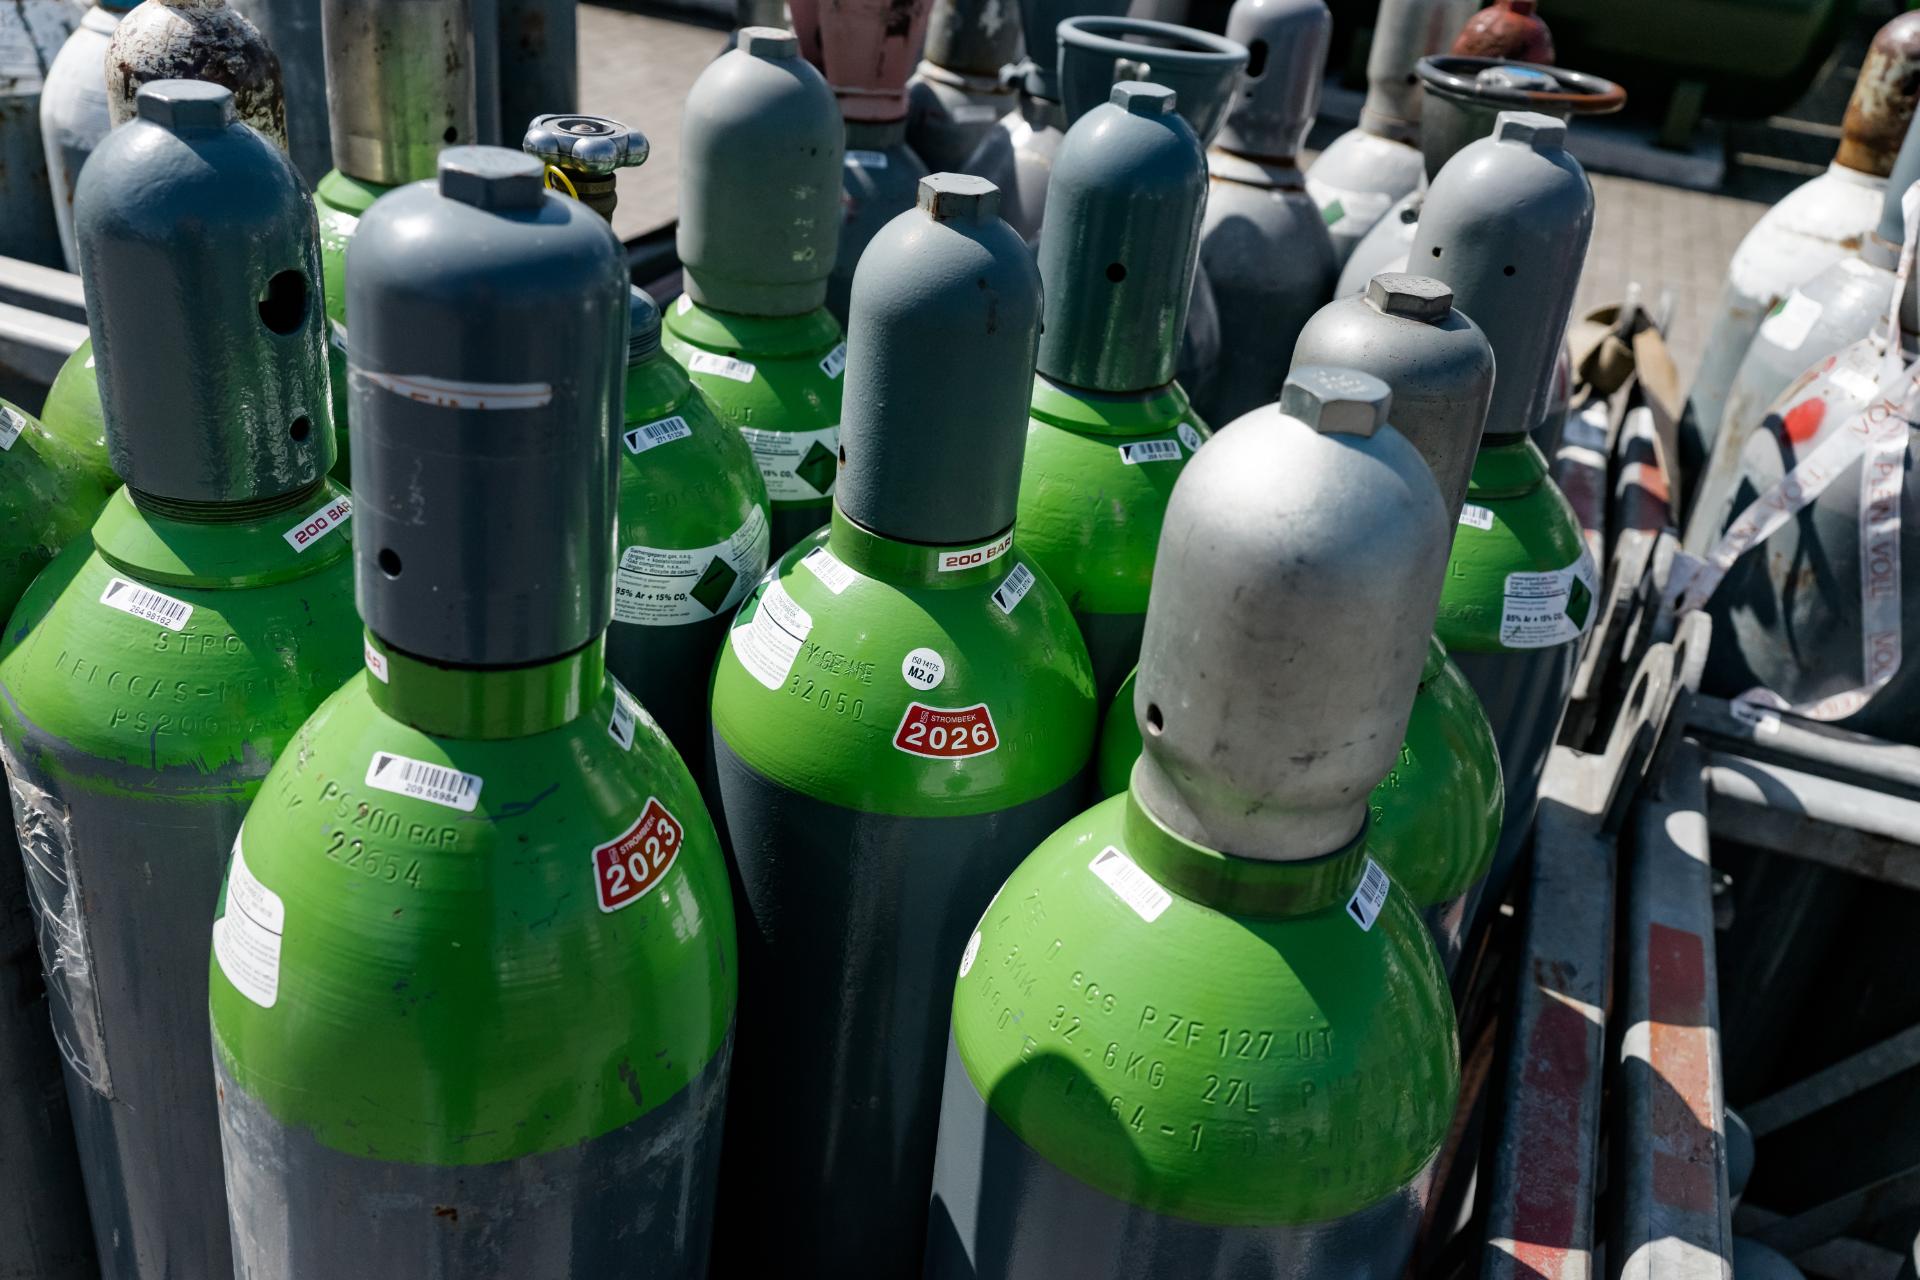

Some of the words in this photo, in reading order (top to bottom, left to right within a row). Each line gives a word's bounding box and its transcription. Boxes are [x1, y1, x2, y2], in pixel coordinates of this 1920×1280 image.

[294, 517, 329, 545] 200
[945, 555, 983, 569] 200
[635, 591, 645, 600] Ar
[656, 593, 672, 602] 15%
[907, 665, 935, 685] M2.0
[911, 655, 922, 665] ISO
[922, 659, 940, 672] 14175
[788, 674, 864, 722] 32050
[930, 713, 977, 724] STROMBEEK
[904, 721, 990, 751] 2026
[619, 814, 656, 855] STROMBEEK
[324, 829, 422, 889] 22654
[606, 817, 676, 898] 2023
[1138, 1004, 1205, 1050] PZF
[1218, 1027, 1274, 1061] 127
[1201, 1074, 1260, 1113] 27L
